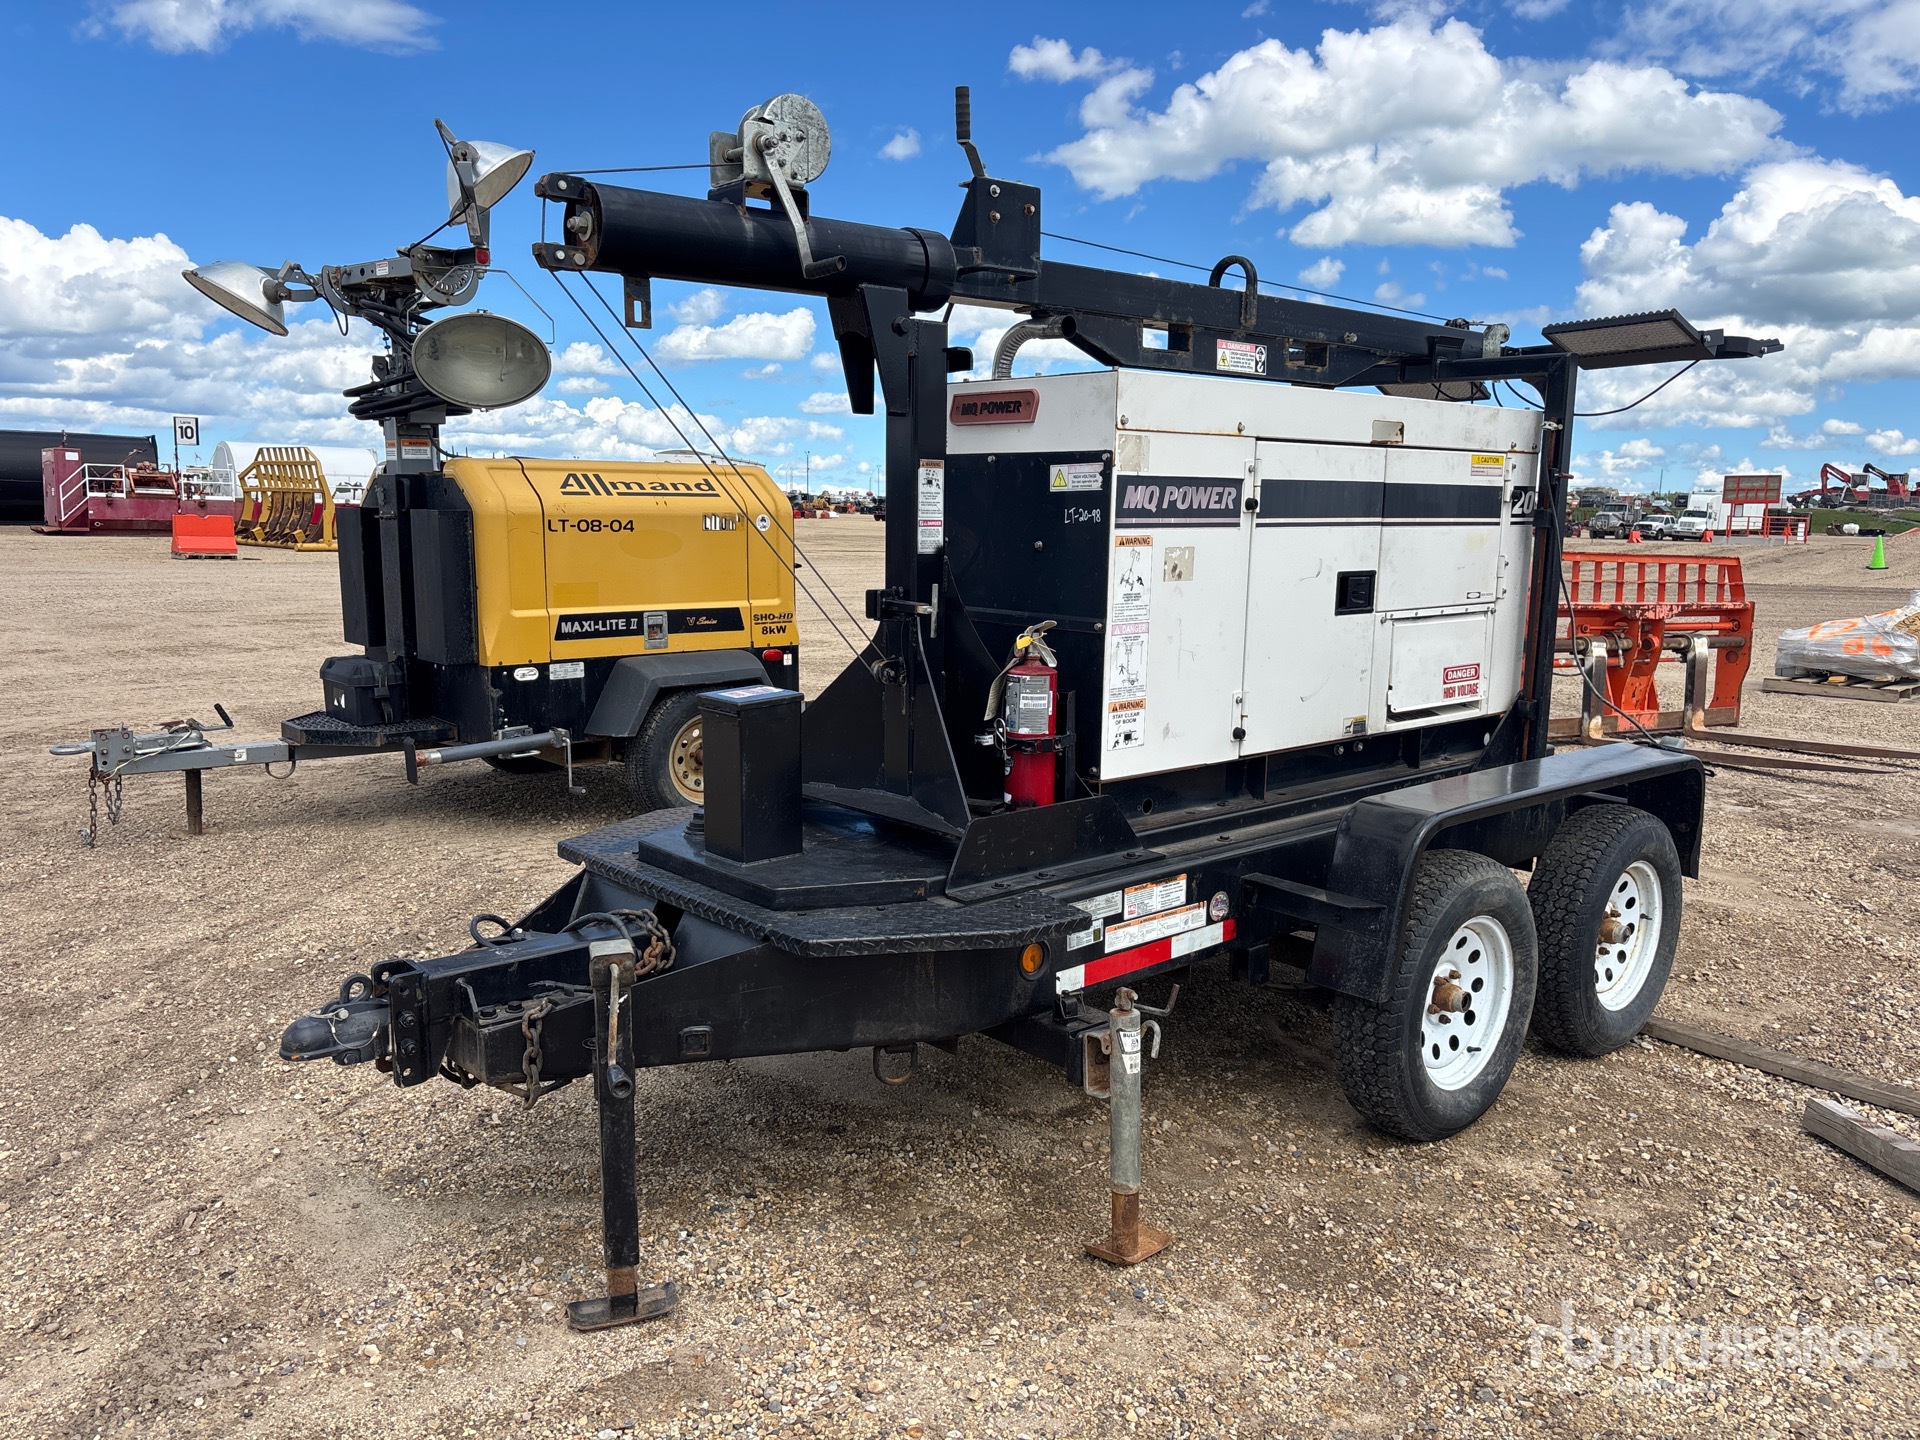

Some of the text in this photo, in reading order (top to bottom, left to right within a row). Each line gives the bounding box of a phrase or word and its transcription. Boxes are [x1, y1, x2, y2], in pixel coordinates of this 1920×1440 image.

[1227, 343, 1251, 352] DANGER
[961, 400, 1022, 416] MQ POWER
[178, 425, 194, 440] 10
[1480, 456, 1500, 464] CAUTION
[559, 473, 716, 496] Allmand
[1123, 485, 1237, 513] MQ POWER
[548, 519, 635, 533] LT-08-04
[1125, 537, 1150, 546] WARNING
[753, 612, 793, 622] SHO-HD
[561, 619, 626, 634] MAXI-LITE
[761, 625, 787, 635] 8kW
[1122, 624, 1147, 633] DANGER
[1447, 668, 1476, 680] DANGER
[1443, 682, 1479, 699] HIGH VOLTAGE
[1118, 700, 1143, 710] WARNING
